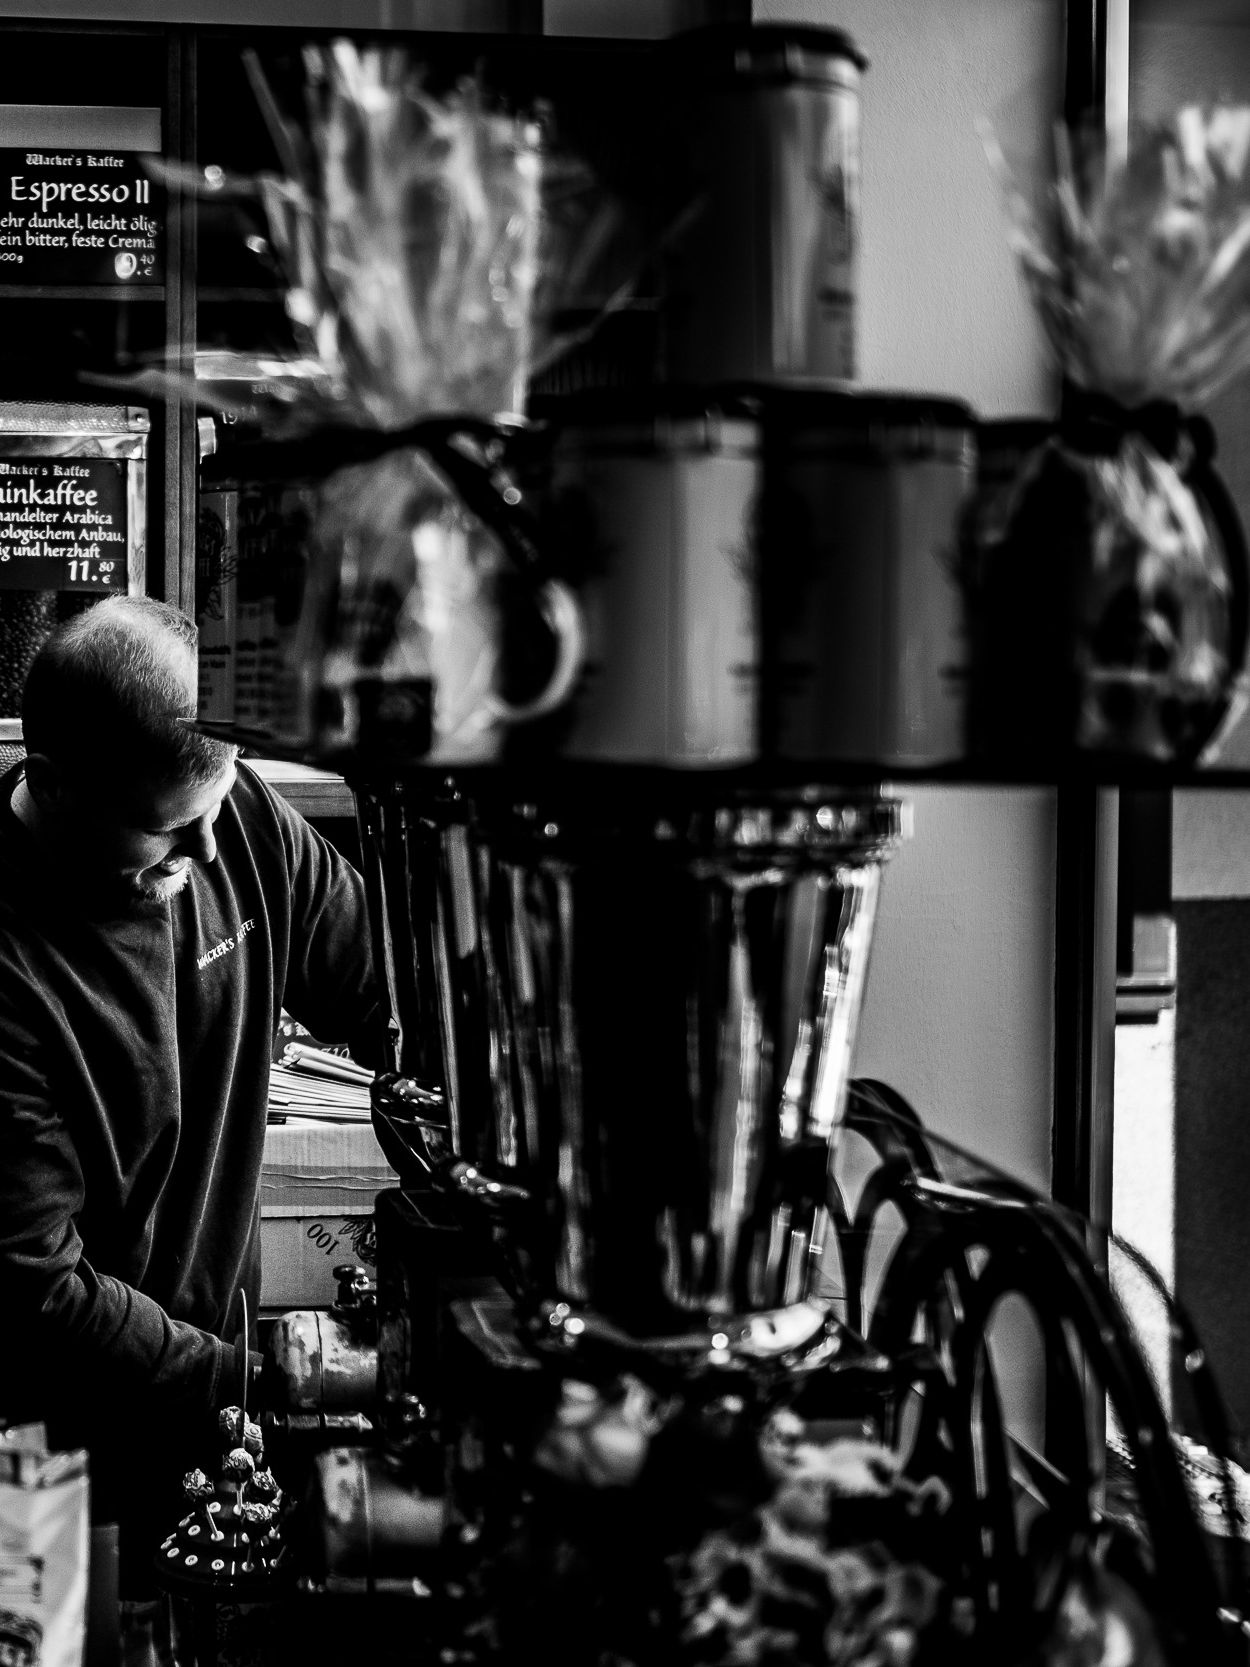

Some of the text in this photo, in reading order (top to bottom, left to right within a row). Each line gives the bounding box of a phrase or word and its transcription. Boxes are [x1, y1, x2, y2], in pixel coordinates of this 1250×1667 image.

[26, 154, 124, 167] Wacker's Kaffee
[10, 176, 129, 213] Espresso
[27, 211, 84, 231] dunkel,
[87, 213, 127, 230] leicht
[130, 214, 157, 238] ölig
[26, 230, 68, 248] bitter,
[72, 231, 105, 247] feste
[108, 234, 156, 249] Crema
[52, 464, 90, 478] Kaffee
[62, 508, 113, 525] Arabica
[78, 526, 125, 543] Anbau,
[13, 542, 41, 557] und
[43, 543, 100, 558] herzhaft
[306, 1223, 340, 1255] 100
